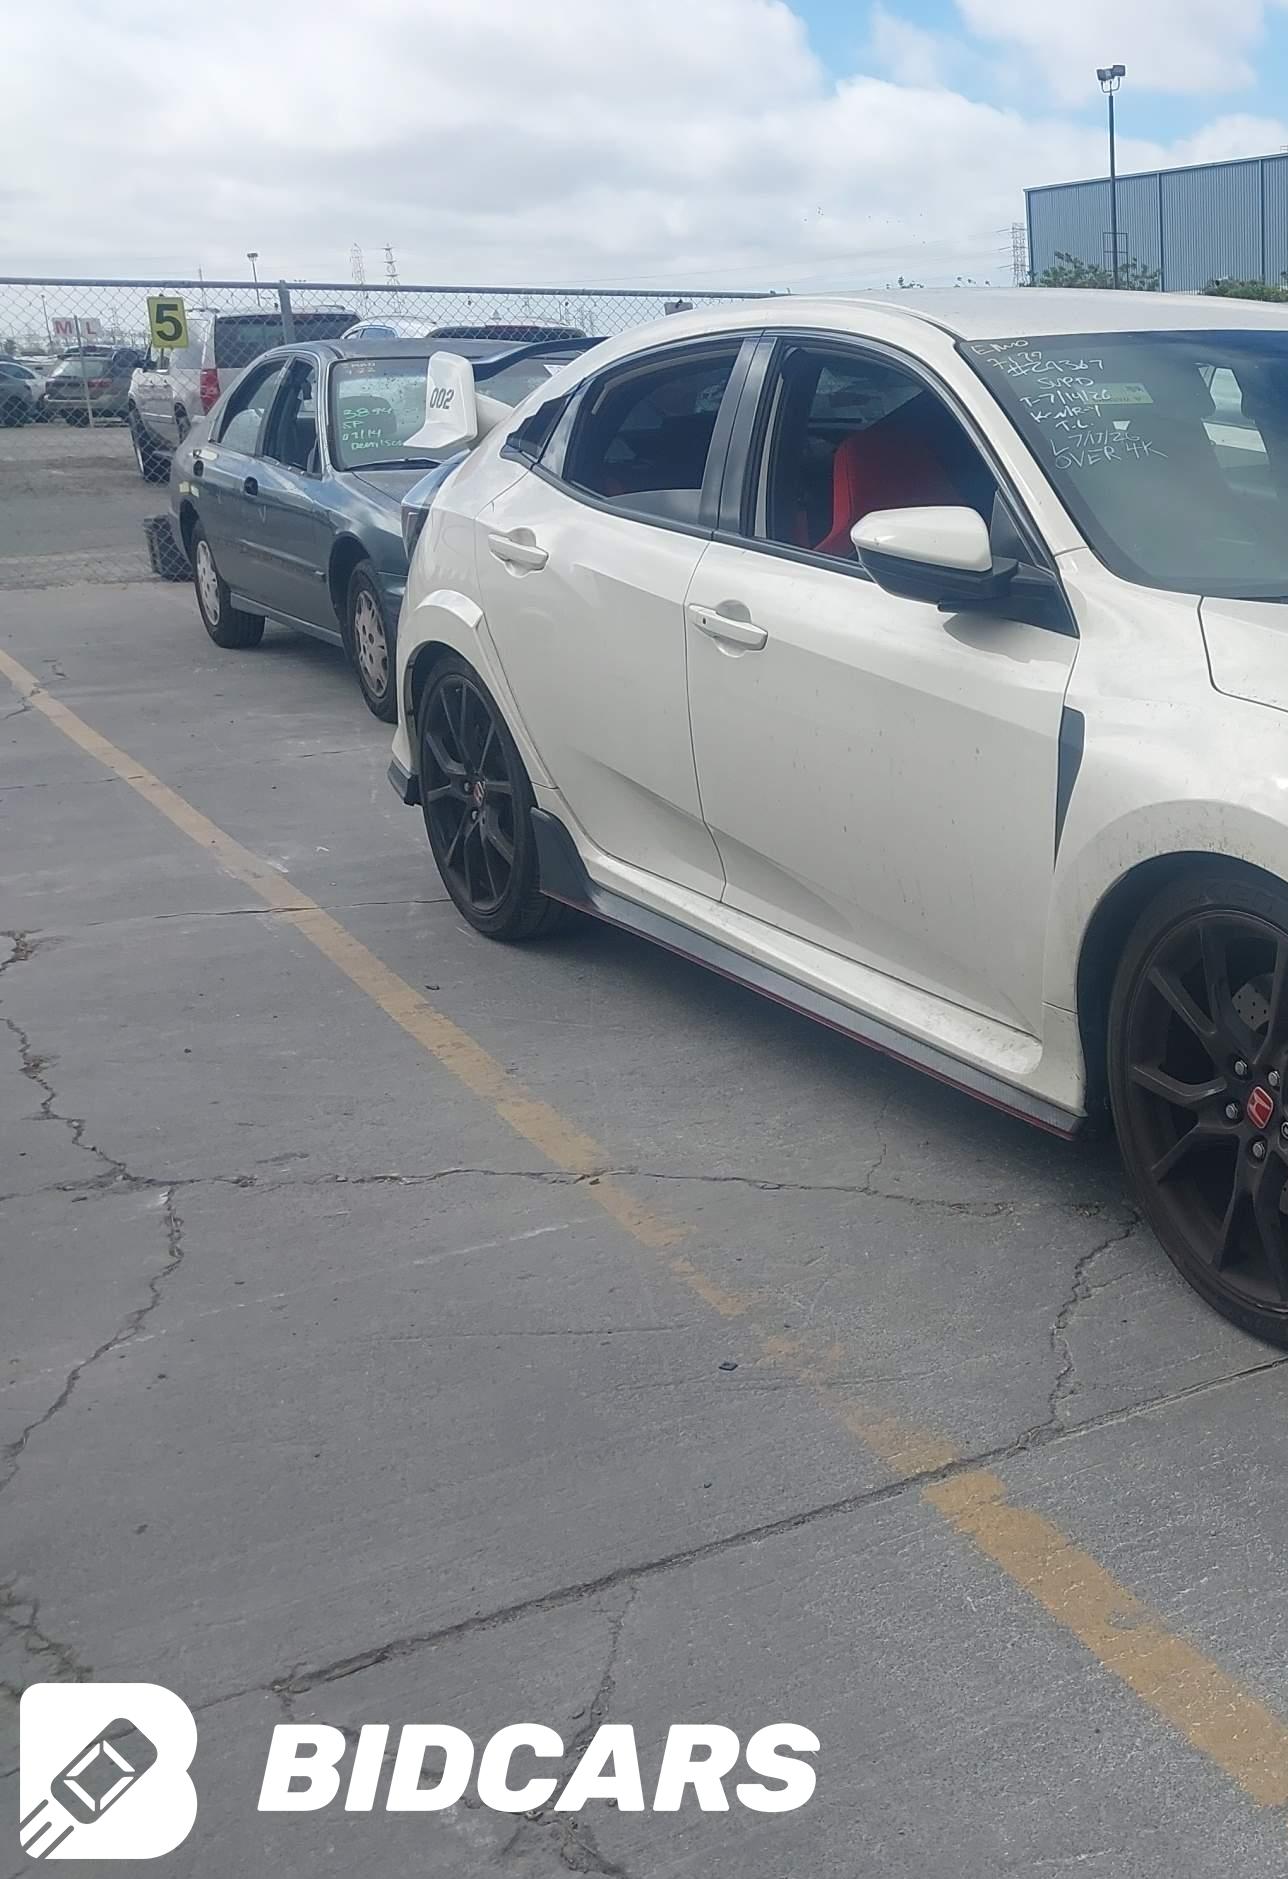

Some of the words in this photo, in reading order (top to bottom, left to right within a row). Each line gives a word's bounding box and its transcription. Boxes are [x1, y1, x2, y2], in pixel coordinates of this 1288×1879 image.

[156, 303, 182, 341] 5
[429, 387, 455, 410] 002
[1055, 445, 1122, 469] OVER
